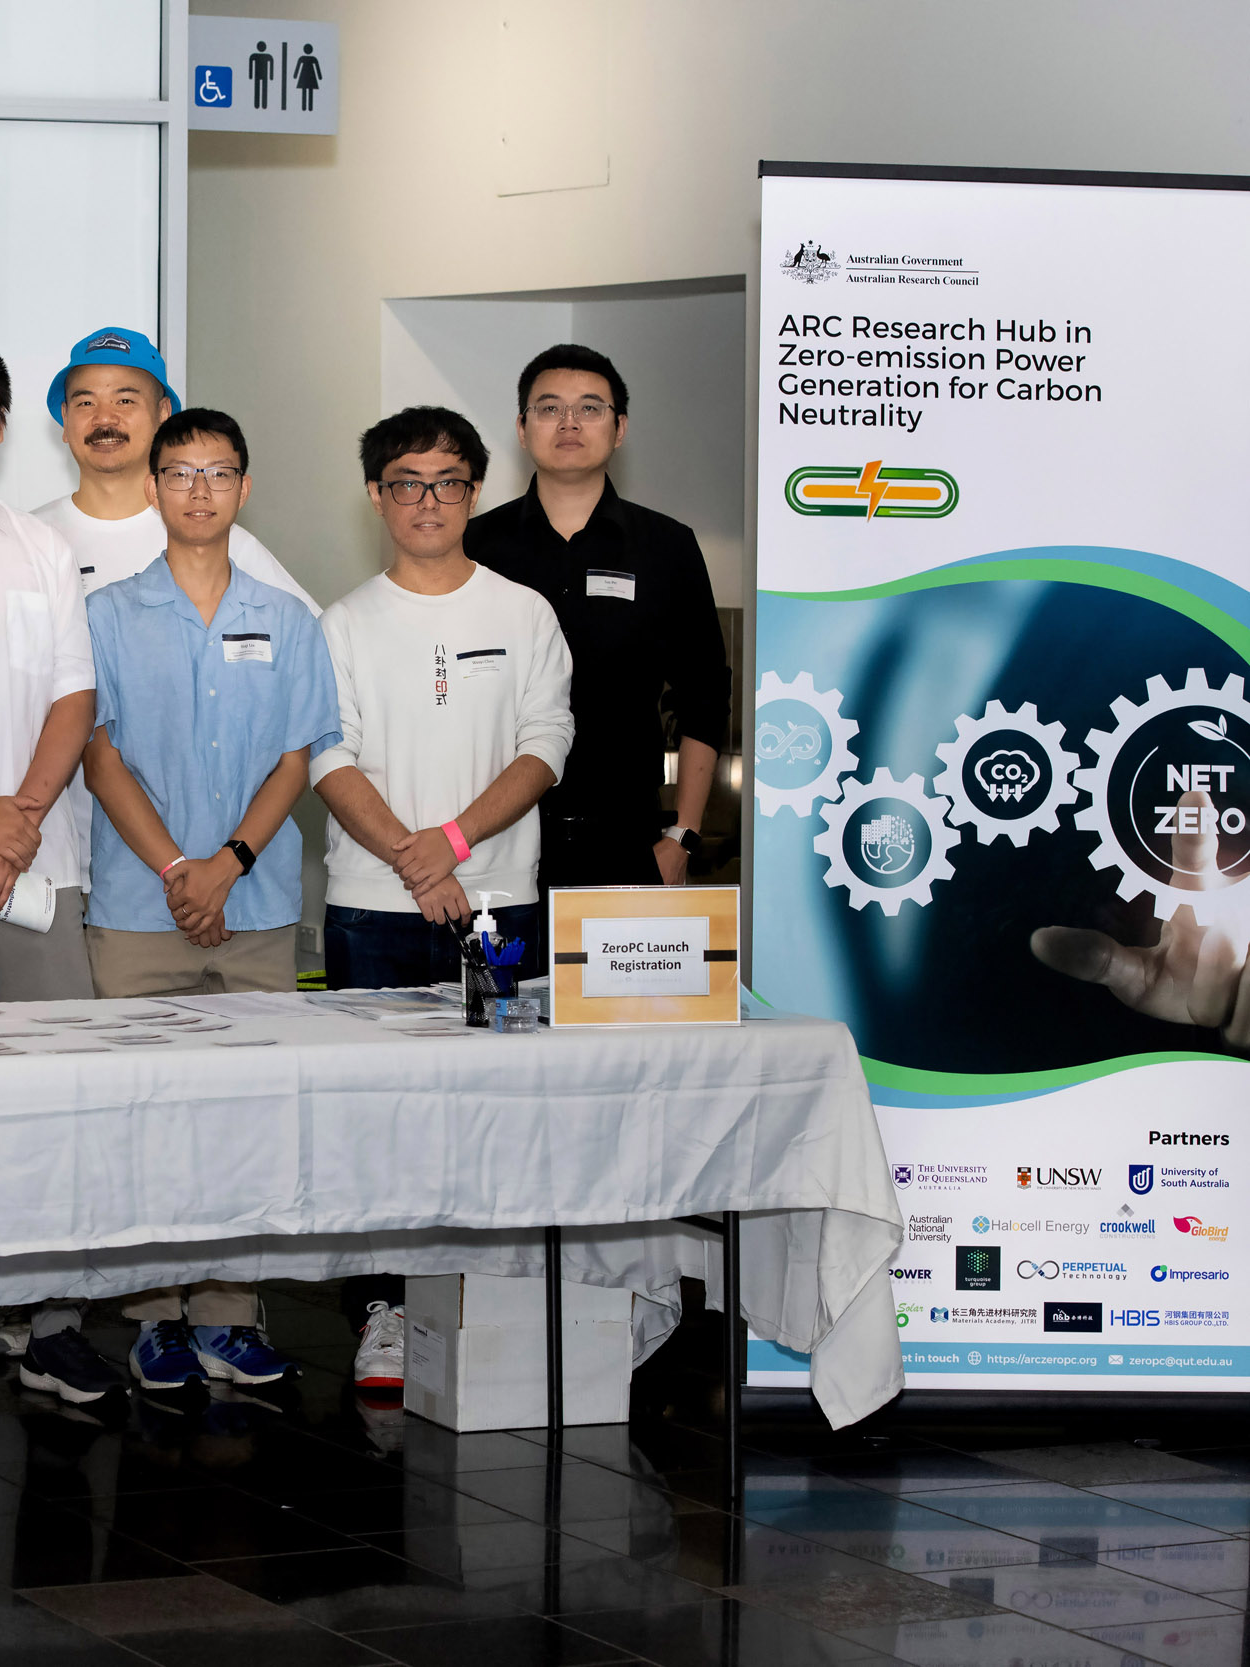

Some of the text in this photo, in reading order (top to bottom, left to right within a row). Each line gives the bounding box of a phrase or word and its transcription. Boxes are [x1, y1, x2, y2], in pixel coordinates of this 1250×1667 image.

[847, 255, 963, 266] Australian Government
[846, 274, 979, 286] Australian Research Council
[779, 315, 1091, 343] ARC Research Hub in
[778, 344, 1086, 372] Zero-emission Power
[778, 373, 1101, 401] Generation for Carbon
[779, 402, 923, 433] Neutrality
[1166, 764, 1235, 793] NET
[1154, 807, 1247, 836] ZERO
[602, 941, 689, 954] ZeroPC Launch
[611, 960, 681, 972] Registration
[1149, 1131, 1229, 1145] Partners
[918, 1164, 988, 1174] THE UNIVERSITY
[1161, 1168, 1219, 1178] University of
[918, 1174, 988, 1184] OF QUEENSLAND
[1037, 1168, 1102, 1185] UNSW
[1161, 1179, 1230, 1188] South Australia
[909, 1215, 953, 1226] Australian
[1100, 1219, 1155, 1233] crookwell
[909, 1224, 945, 1235] National
[992, 1220, 1089, 1234] Halocell Energy
[1191, 1226, 1228, 1238] GloBird
[909, 1233, 952, 1244] University
[1100, 1233, 1158, 1241] CONSTRUCTIONS
[1063, 1263, 1127, 1273] PERPETUAL
[1063, 1273, 1127, 1281] Technology
[1170, 1269, 1229, 1282] Impresario
[897, 1303, 924, 1314] Solar
[952, 1308, 1037, 1319] 长三角先进材料研究院
[1111, 1310, 1160, 1326] HBIS
[1165, 1311, 1230, 1320] 河钢集团有限公司
[901, 1353, 1233, 1368] et in touch https://arczeropc.org zeropc@qut.edu.au
